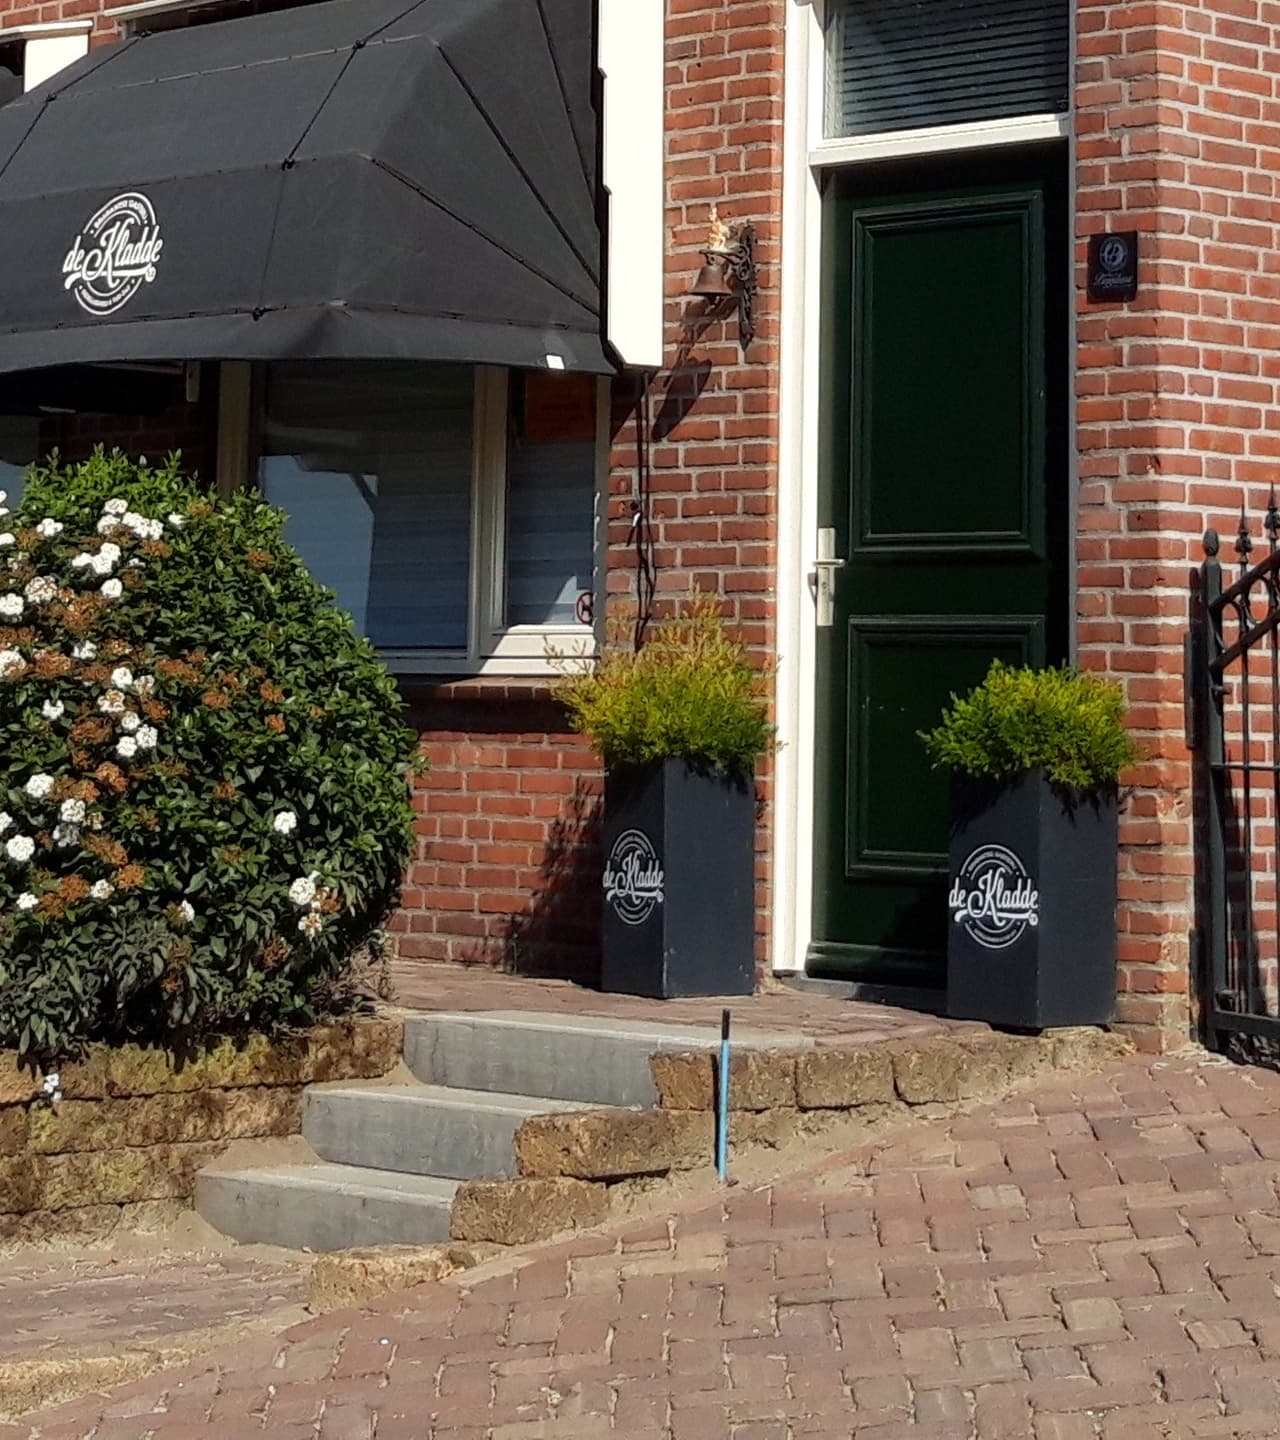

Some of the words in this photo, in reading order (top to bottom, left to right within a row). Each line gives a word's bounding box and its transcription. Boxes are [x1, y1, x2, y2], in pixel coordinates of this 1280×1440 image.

[62, 235, 85, 272] de
[81, 217, 163, 288] Kladde
[602, 860, 616, 888] de
[615, 850, 665, 904] Kladde
[949, 877, 966, 908] de
[967, 867, 1039, 927] Kladde
